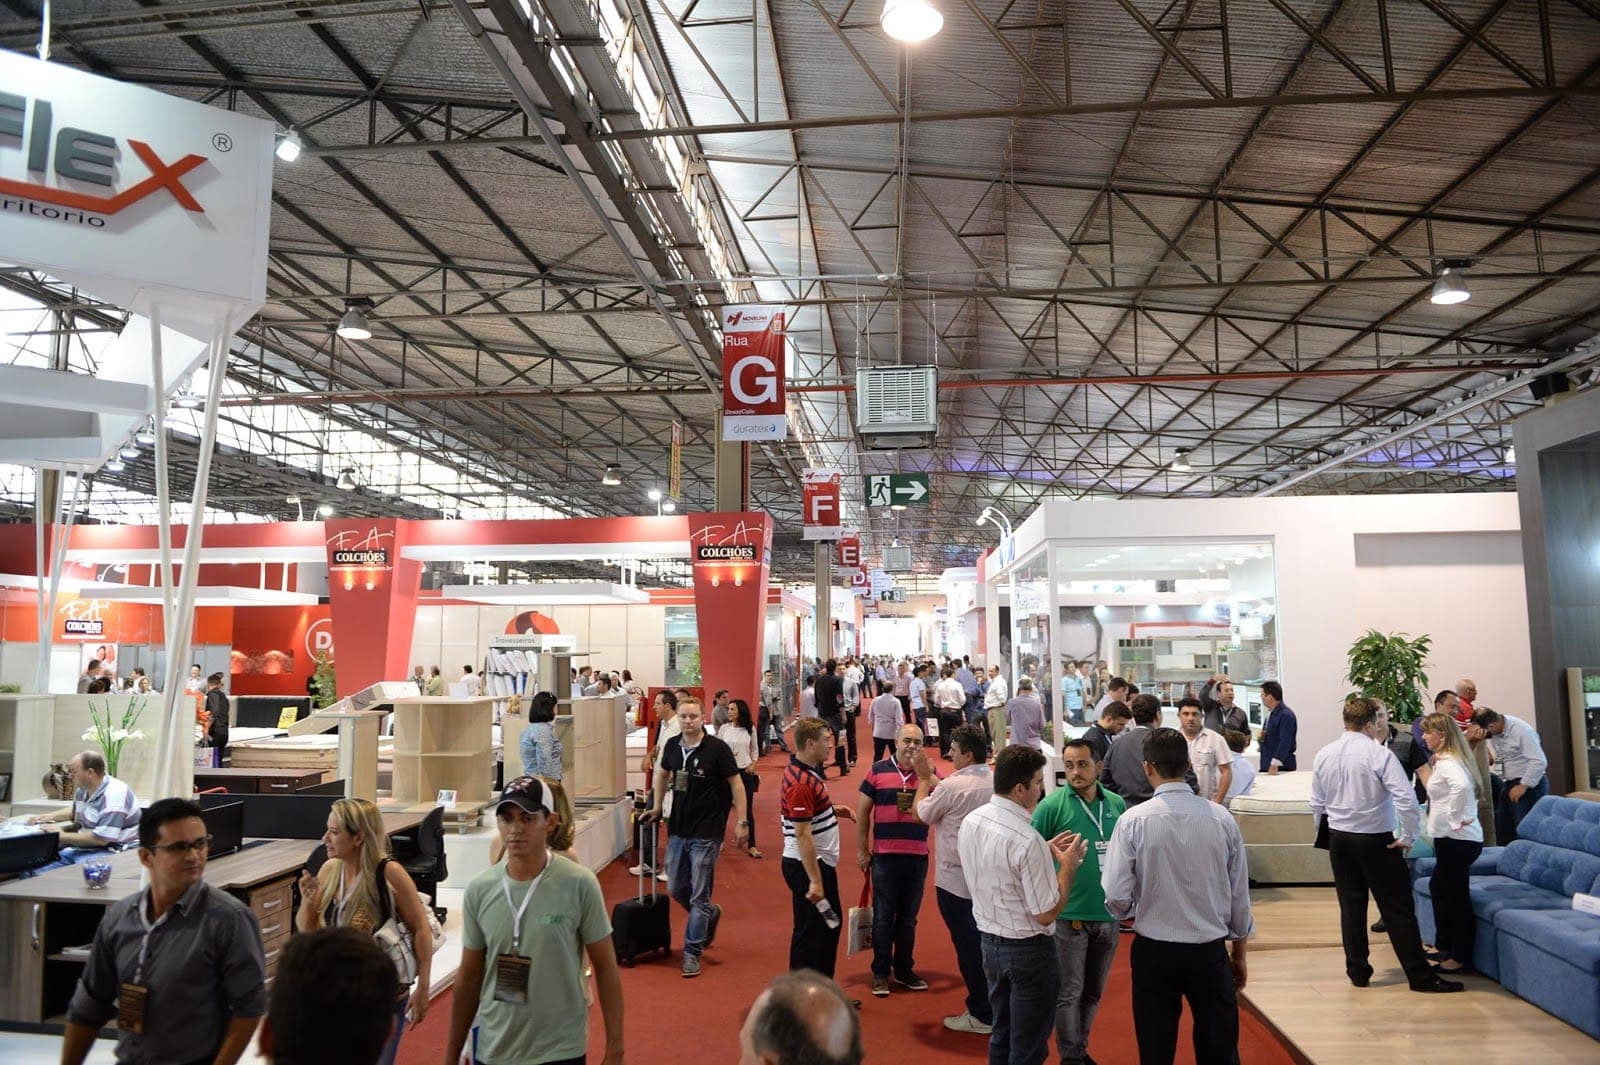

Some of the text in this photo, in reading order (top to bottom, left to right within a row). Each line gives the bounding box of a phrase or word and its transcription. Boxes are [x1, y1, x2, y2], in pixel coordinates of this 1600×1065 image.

[725, 335, 748, 346] Rua
[730, 355, 777, 405] G
[733, 423, 769, 434] duratex
[812, 495, 833, 521] F
[335, 550, 385, 562] COLCHÕES
[700, 546, 754, 561] COLCHÕES
[842, 546, 857, 564] E
